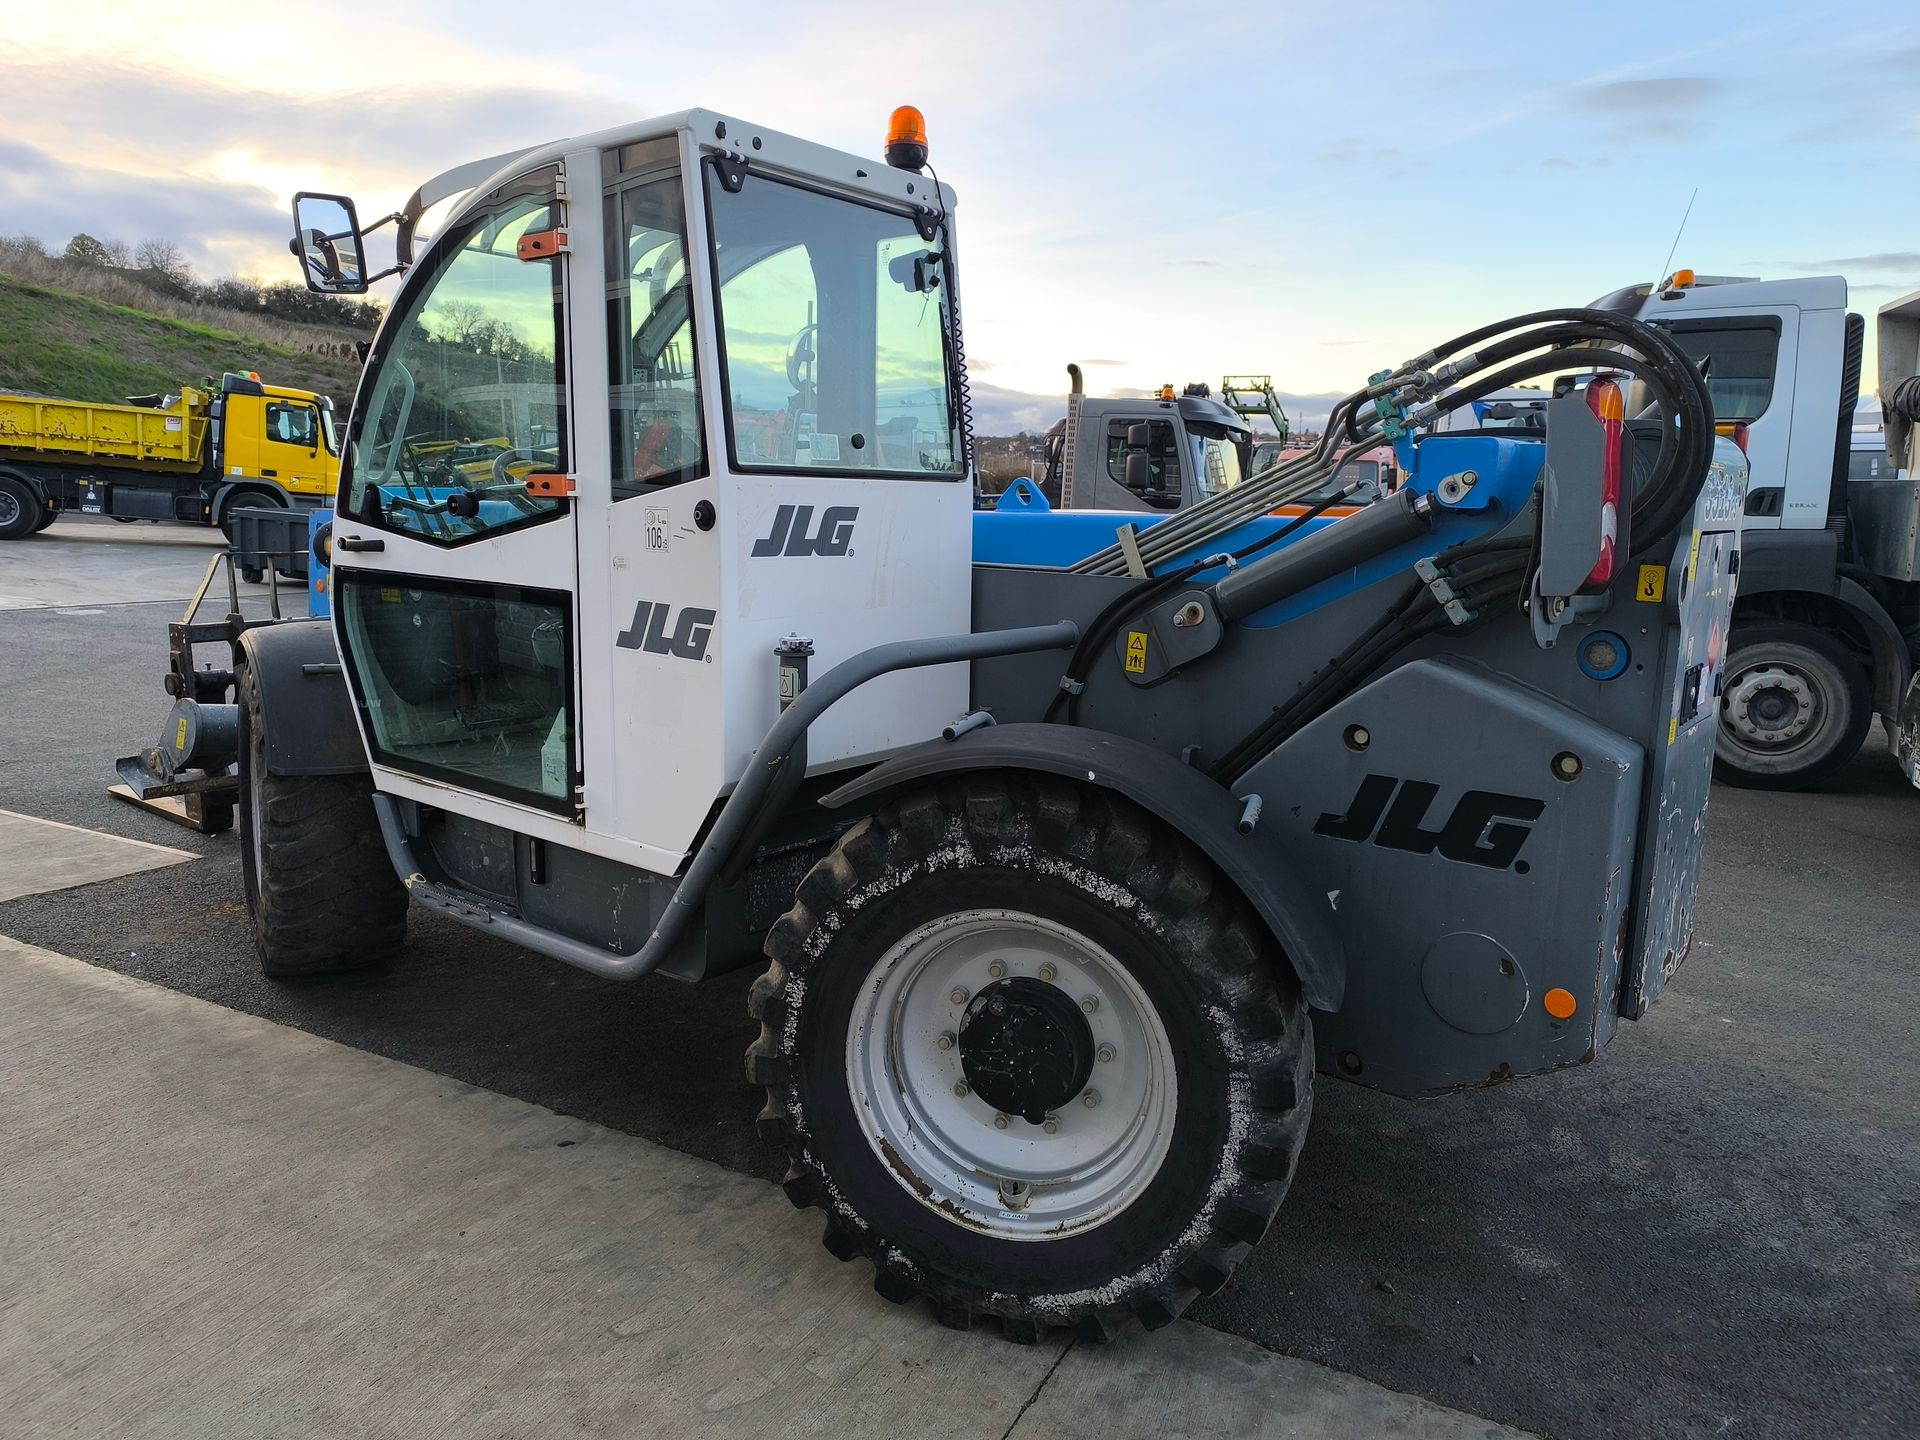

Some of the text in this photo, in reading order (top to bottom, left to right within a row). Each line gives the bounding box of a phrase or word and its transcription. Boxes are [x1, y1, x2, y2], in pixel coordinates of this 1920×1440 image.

[646, 527, 662, 548] 106
[750, 504, 860, 557] JLG
[616, 600, 717, 661] JLG
[1312, 773, 1548, 871] JLG
